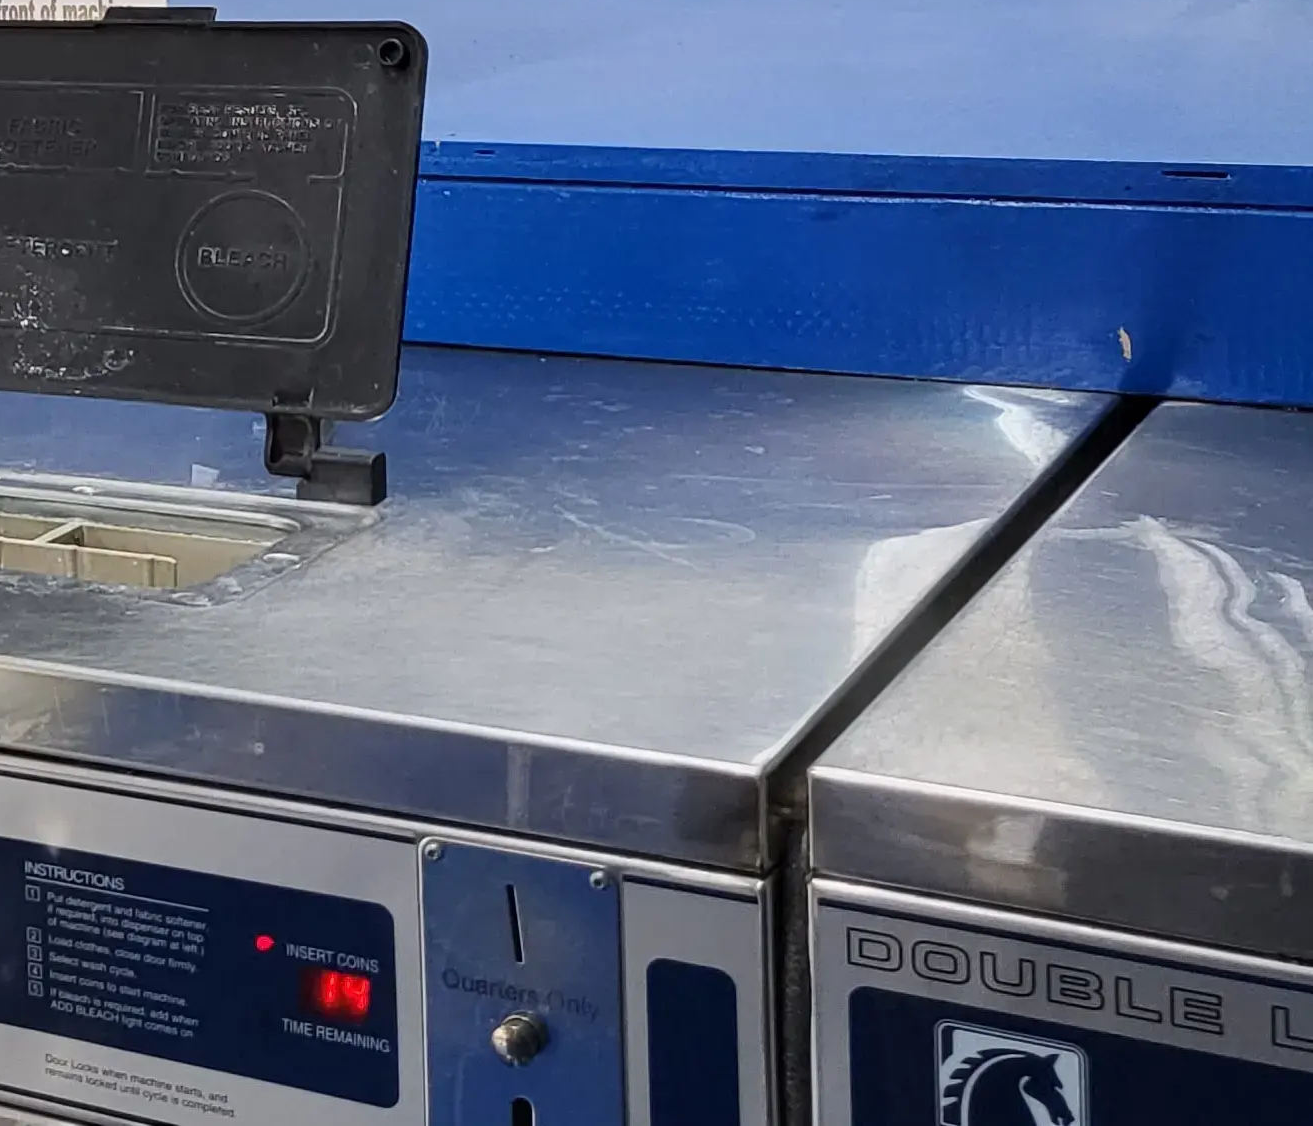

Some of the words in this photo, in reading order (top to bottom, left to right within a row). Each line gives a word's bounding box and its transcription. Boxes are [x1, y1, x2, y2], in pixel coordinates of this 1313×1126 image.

[197, 245, 287, 270] BLEACH
[24, 860, 125, 891] INSTRUCTIONS
[46, 891, 64, 903] Put
[65, 895, 112, 914] detergent
[114, 906, 132, 917] and
[135, 908, 162, 922] fabric
[48, 952, 79, 967] Select
[81, 959, 107, 973] wash
[285, 942, 333, 964] INSERT
[336, 952, 379, 973] COINS
[323, 972, 371, 1011] 14
[441, 967, 539, 1006] Quarters
[846, 927, 1224, 1035] DOUBLE
[50, 1000, 73, 1014] ADD
[75, 1005, 119, 1023] BLEACH
[121, 1014, 143, 1029] light
[144, 1020, 178, 1036] comes
[282, 1017, 313, 1038] TIME
[315, 1024, 390, 1053] REMAINING
[45, 1053, 69, 1067] Door
[70, 1059, 99, 1073] Locks
[101, 1066, 128, 1081] when
[130, 1074, 172, 1091] machine
[208, 1092, 228, 1103] and
[45, 1067, 83, 1083] remains
[85, 1075, 117, 1091] locked
[119, 1084, 140, 1097] until
[142, 1089, 168, 1103] cycle
[171, 1095, 179, 1105] is
